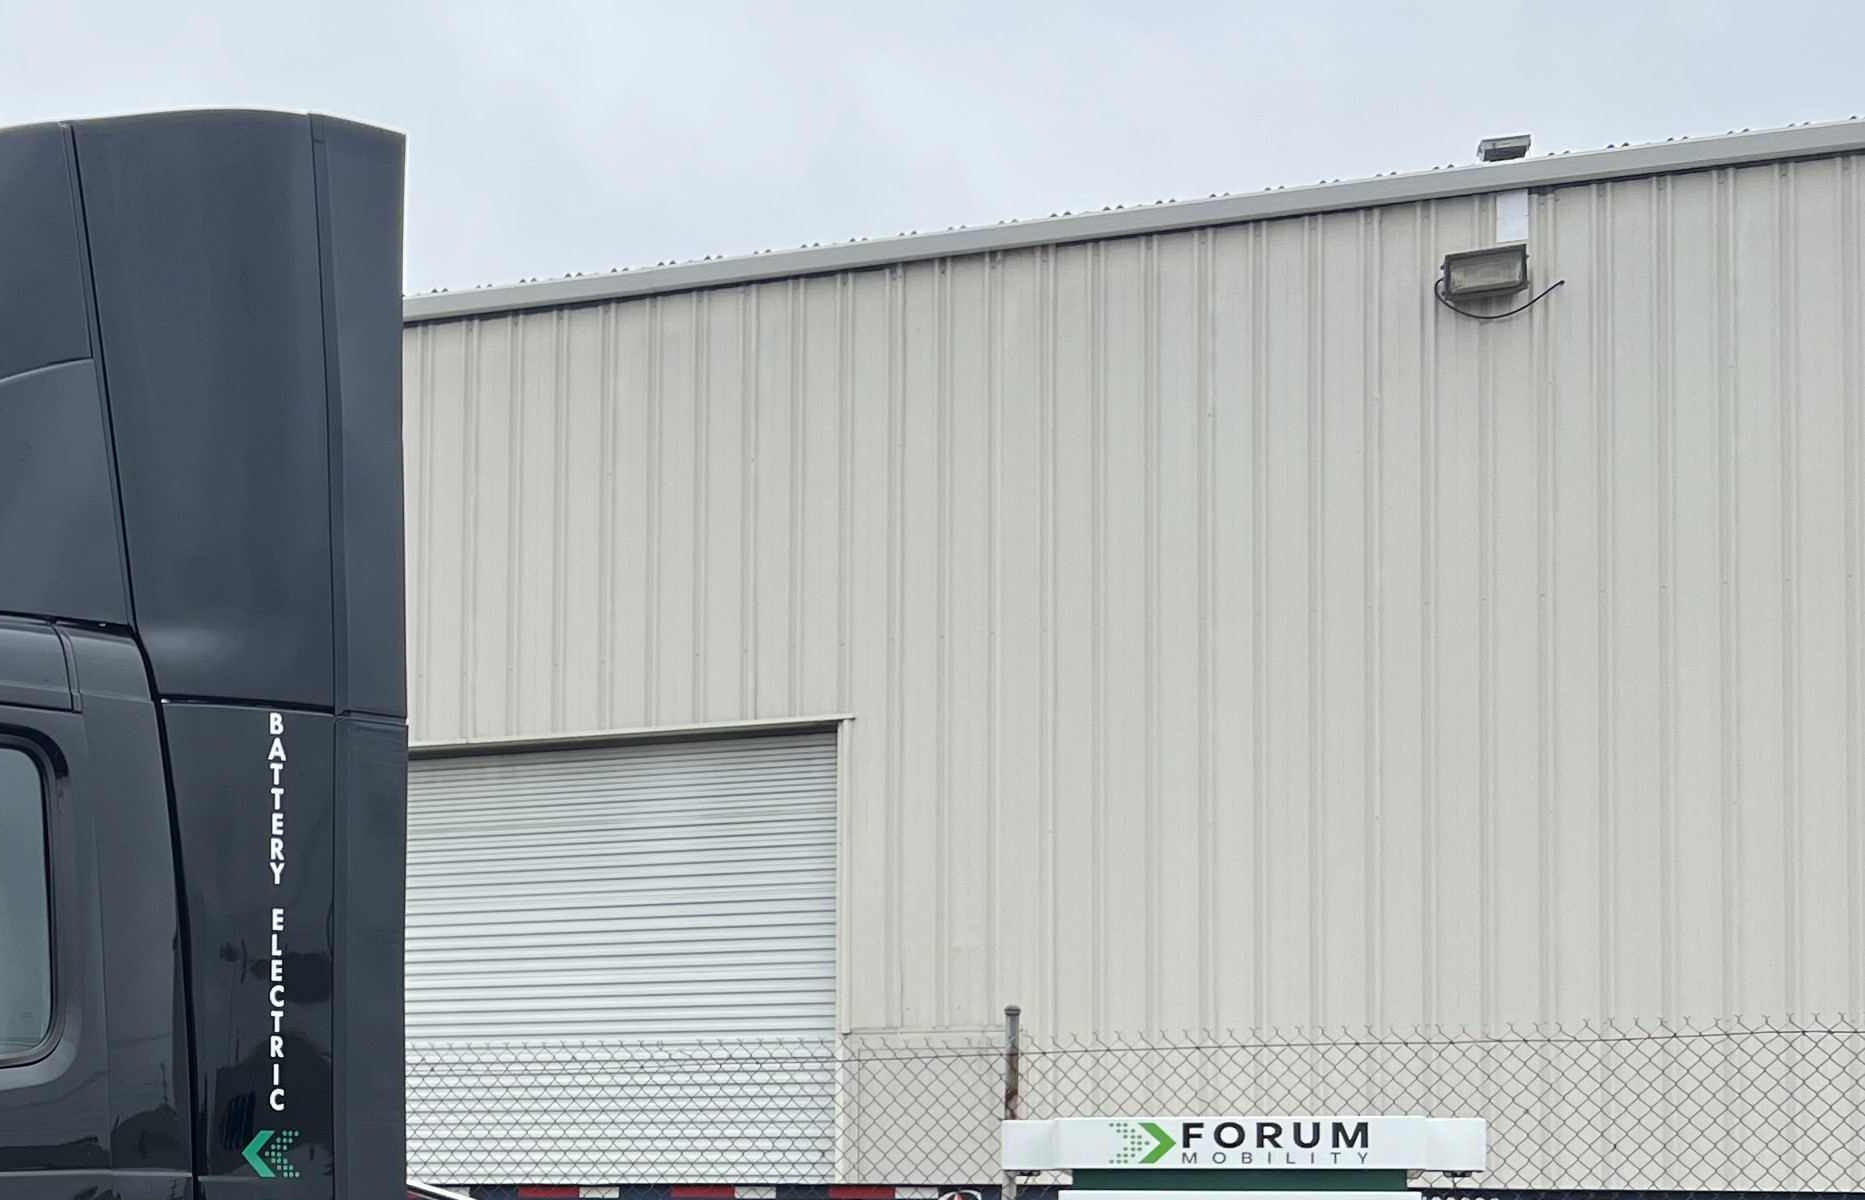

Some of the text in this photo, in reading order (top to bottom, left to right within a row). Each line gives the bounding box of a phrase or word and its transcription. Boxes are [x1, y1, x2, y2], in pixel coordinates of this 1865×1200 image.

[267, 712, 286, 1111] BATTERY ELECTRIC
[1182, 1121, 1370, 1150] FORUM
[1182, 1152, 1369, 1165] MOBILITY
